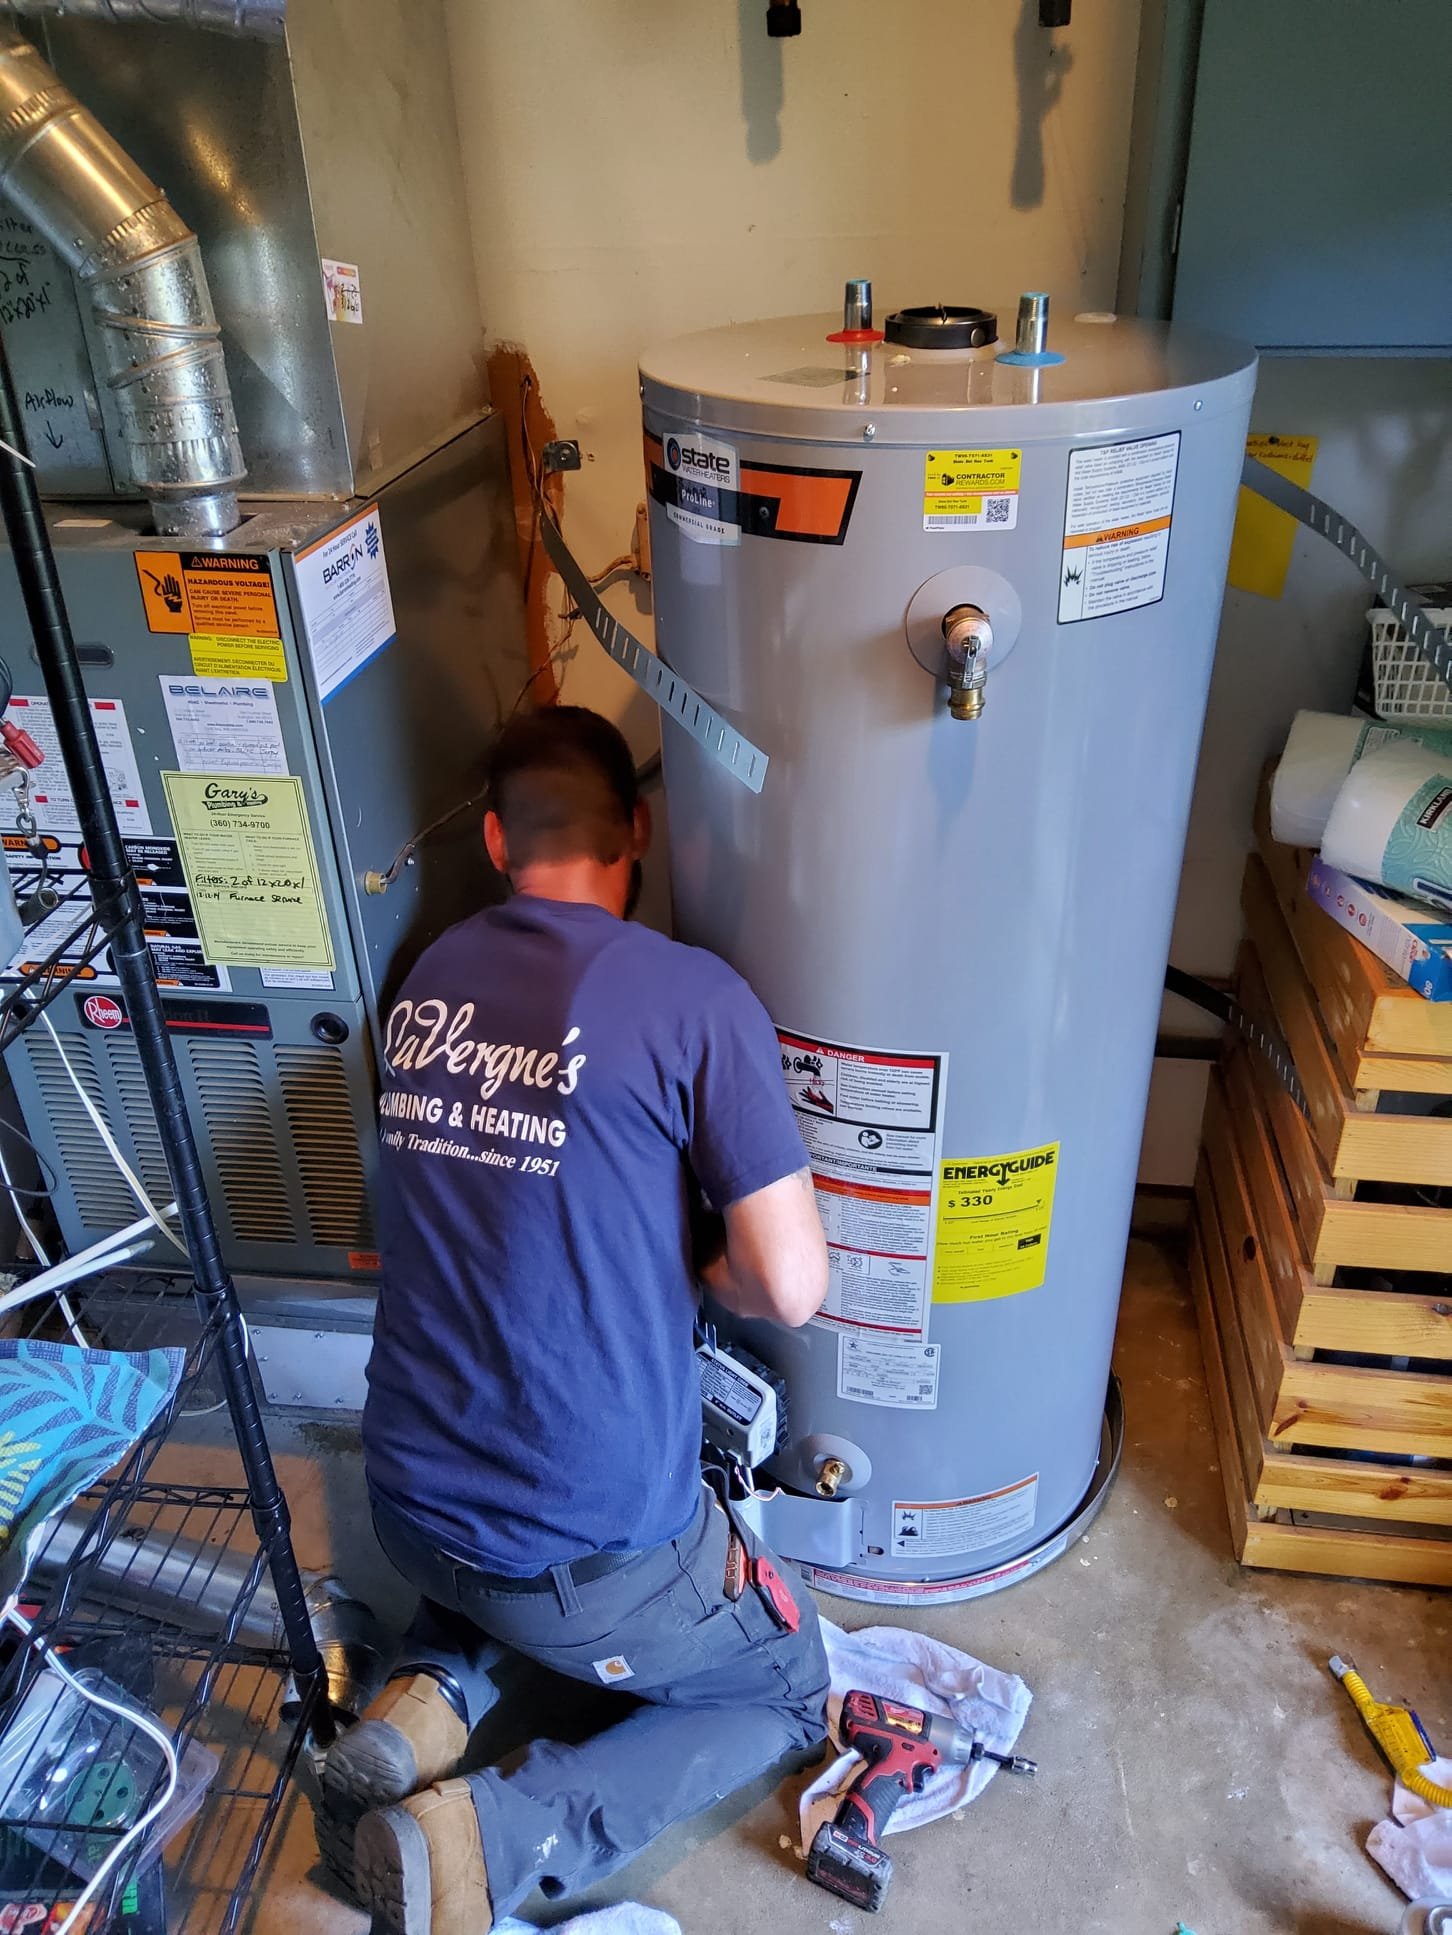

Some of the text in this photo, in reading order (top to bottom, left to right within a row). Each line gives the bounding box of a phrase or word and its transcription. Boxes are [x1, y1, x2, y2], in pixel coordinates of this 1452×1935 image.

[25, 389, 73, 411] Airflow
[681, 447, 730, 474] state
[702, 470, 730, 484] HEATERS
[673, 512, 725, 534] COMMERCIAL GRADE
[1103, 528, 1139, 541] WARNING
[202, 557, 259, 570] WARNING
[235, 580, 270, 588] VOLTAGE!
[169, 685, 268, 697] BELAIRE
[205, 782, 259, 803] Gary's
[210, 819, 270, 829] (360) 734-9700
[231, 876, 239, 886] 2
[242, 875, 253, 886] of
[229, 893, 265, 902] Furnace
[87, 997, 120, 1023] Rheem
[384, 999, 586, 1100] LaVergne's
[827, 1049, 865, 1063] DANGER
[448, 1101, 463, 1128] &
[470, 1105, 566, 1147] HEATING
[518, 1156, 560, 1177] 1951
[943, 1151, 1055, 1180] ENERGYGUIDE
[948, 1195, 993, 1208] $ 330
